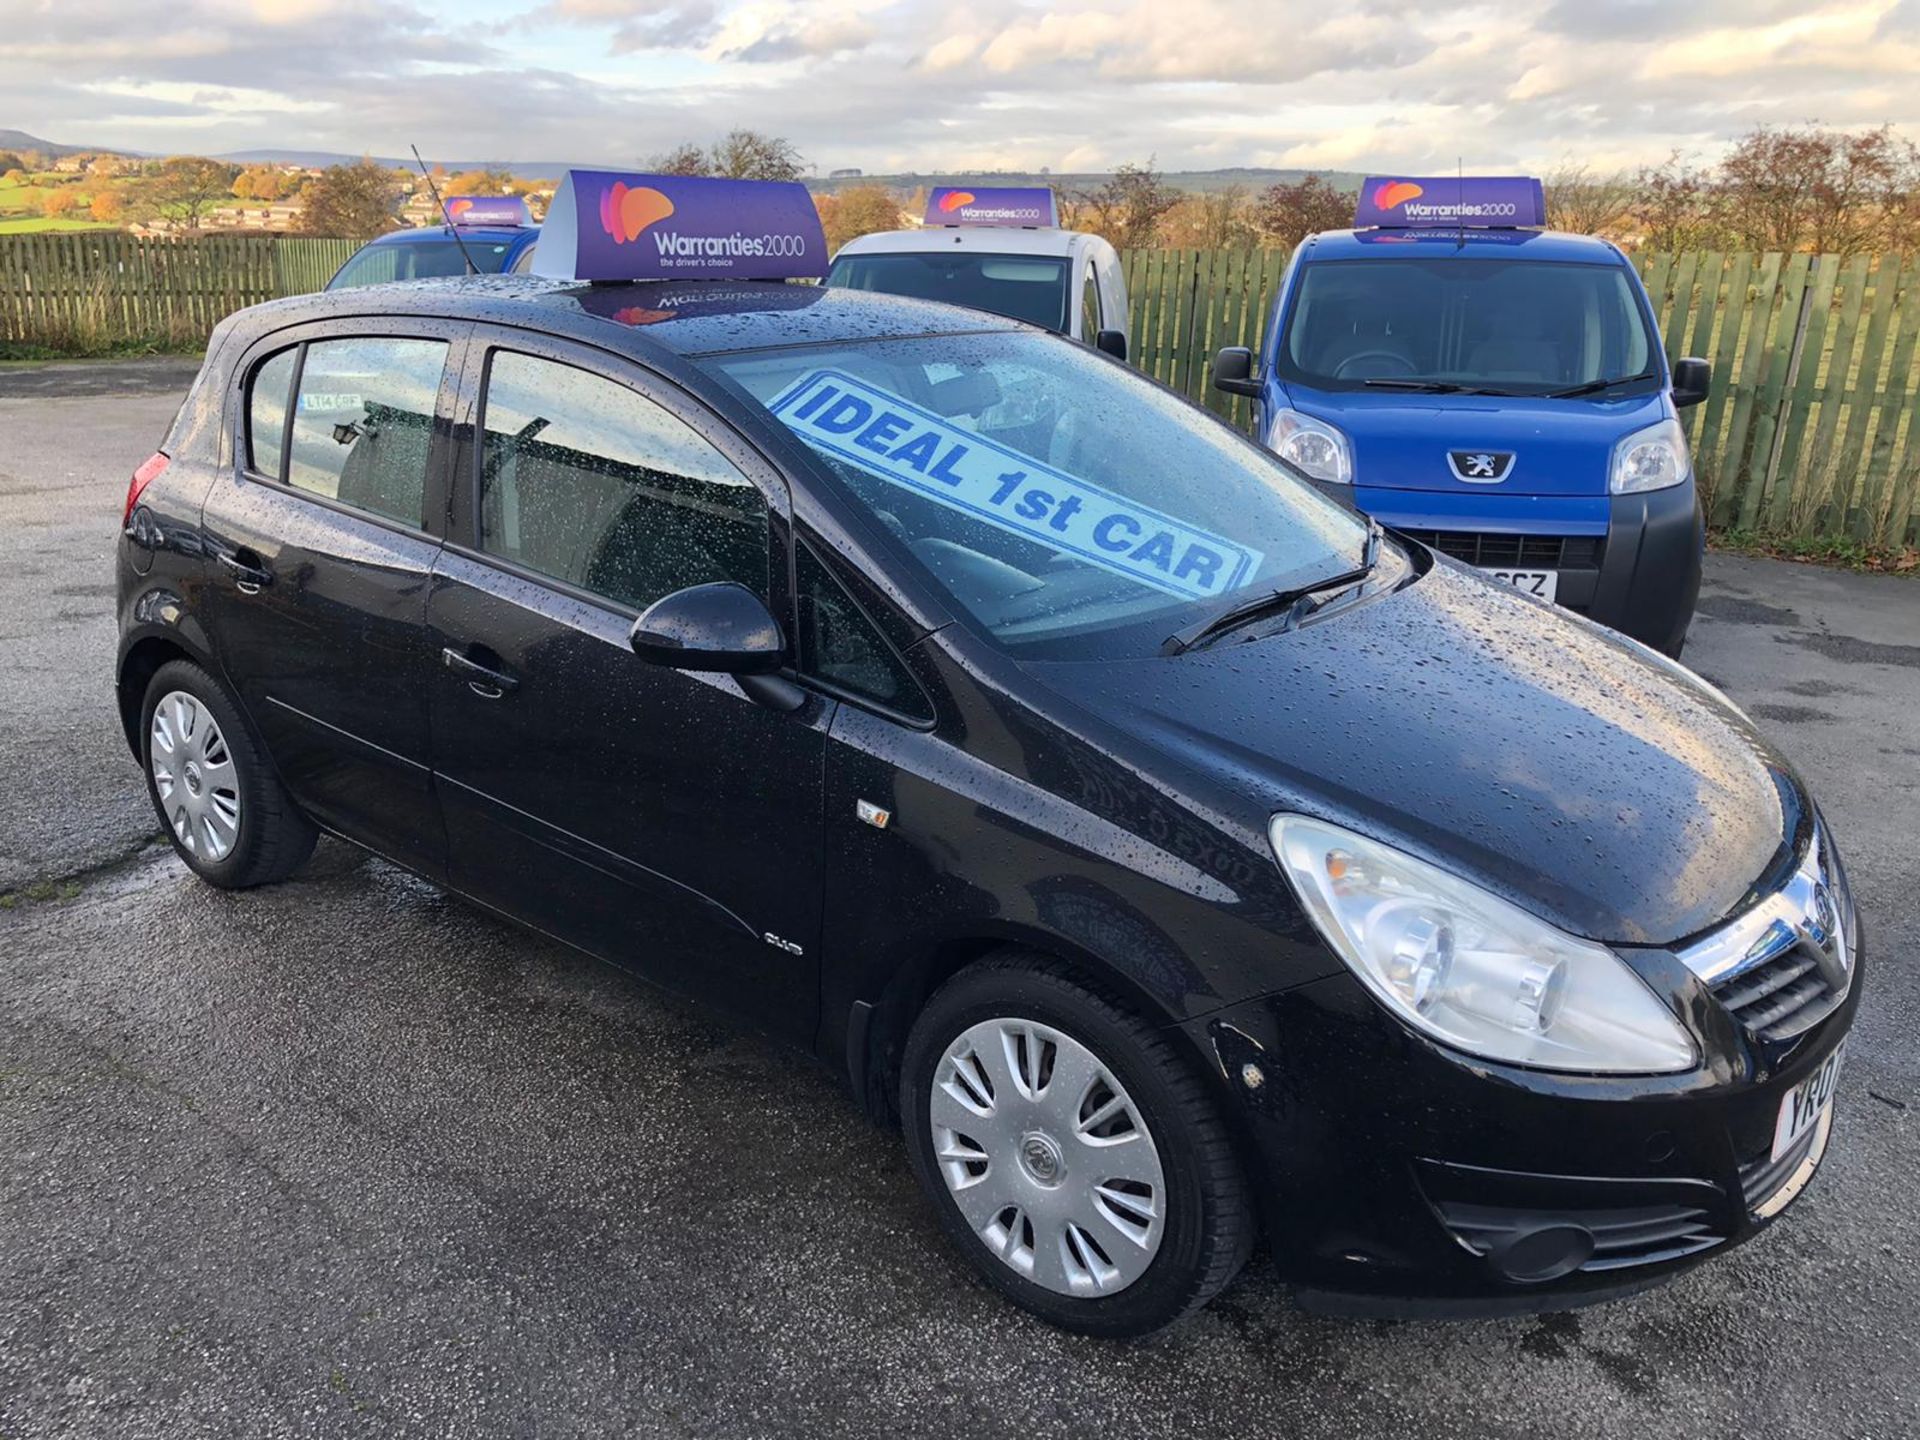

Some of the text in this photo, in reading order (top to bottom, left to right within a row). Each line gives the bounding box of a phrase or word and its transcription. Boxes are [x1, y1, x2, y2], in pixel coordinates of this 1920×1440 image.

[1404, 202, 1516, 217] Warranties2000
[653, 231, 805, 257] Warranties2000
[660, 258, 734, 267] the driver's choice
[795, 385, 1224, 589] IDEAL 1st CAR
